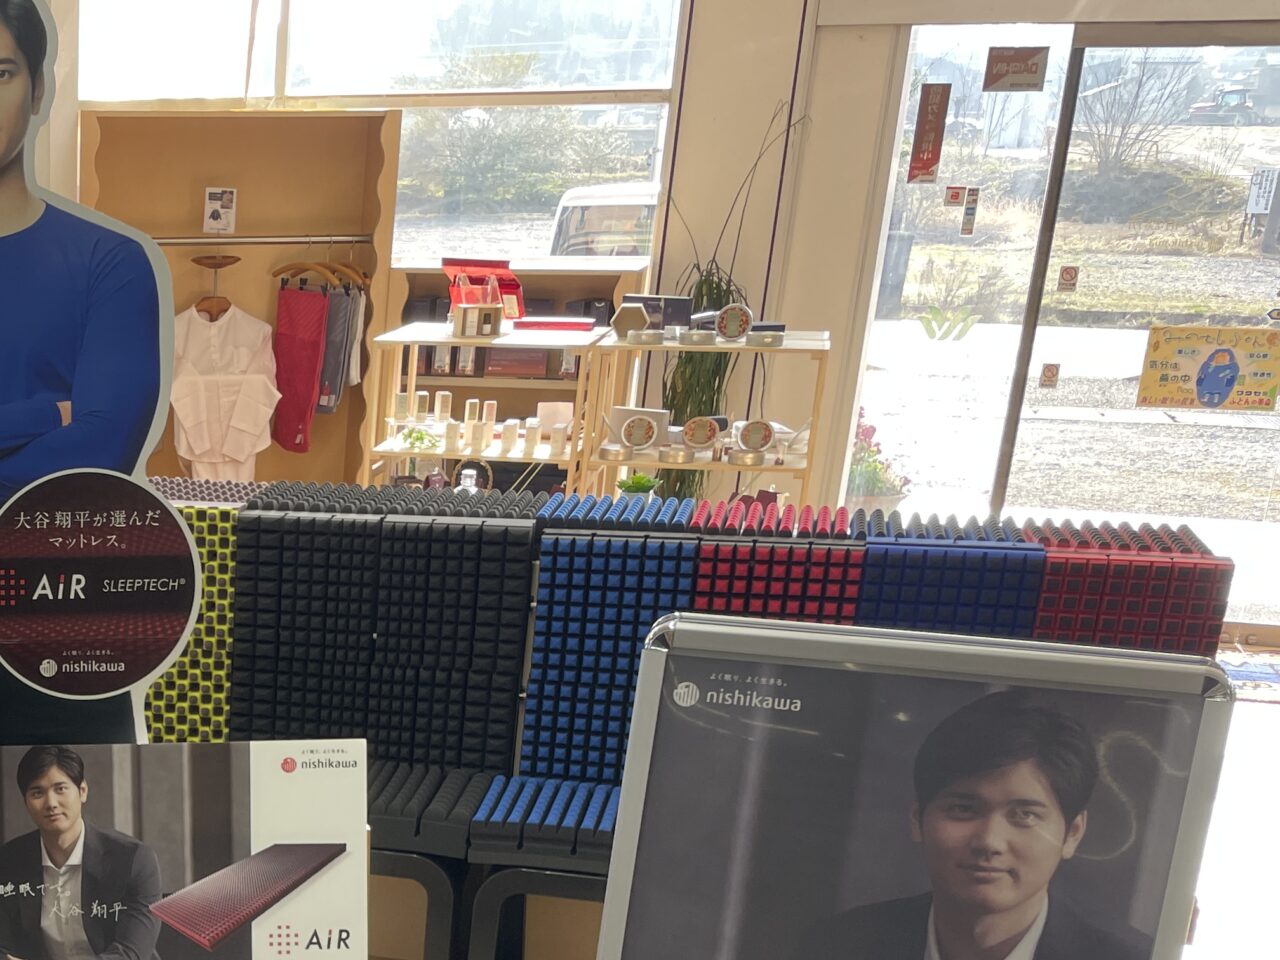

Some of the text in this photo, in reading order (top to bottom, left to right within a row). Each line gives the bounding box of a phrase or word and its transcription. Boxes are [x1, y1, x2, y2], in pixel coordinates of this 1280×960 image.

[14, 509, 161, 530] 大谷翔平が選んだ
[49, 533, 127, 550] マットレス。
[32, 573, 86, 600] AiR
[62, 661, 125, 674] nishikawa
[706, 688, 802, 712] nishikawa
[301, 757, 358, 770] nishikawa
[305, 928, 351, 950] AiR
